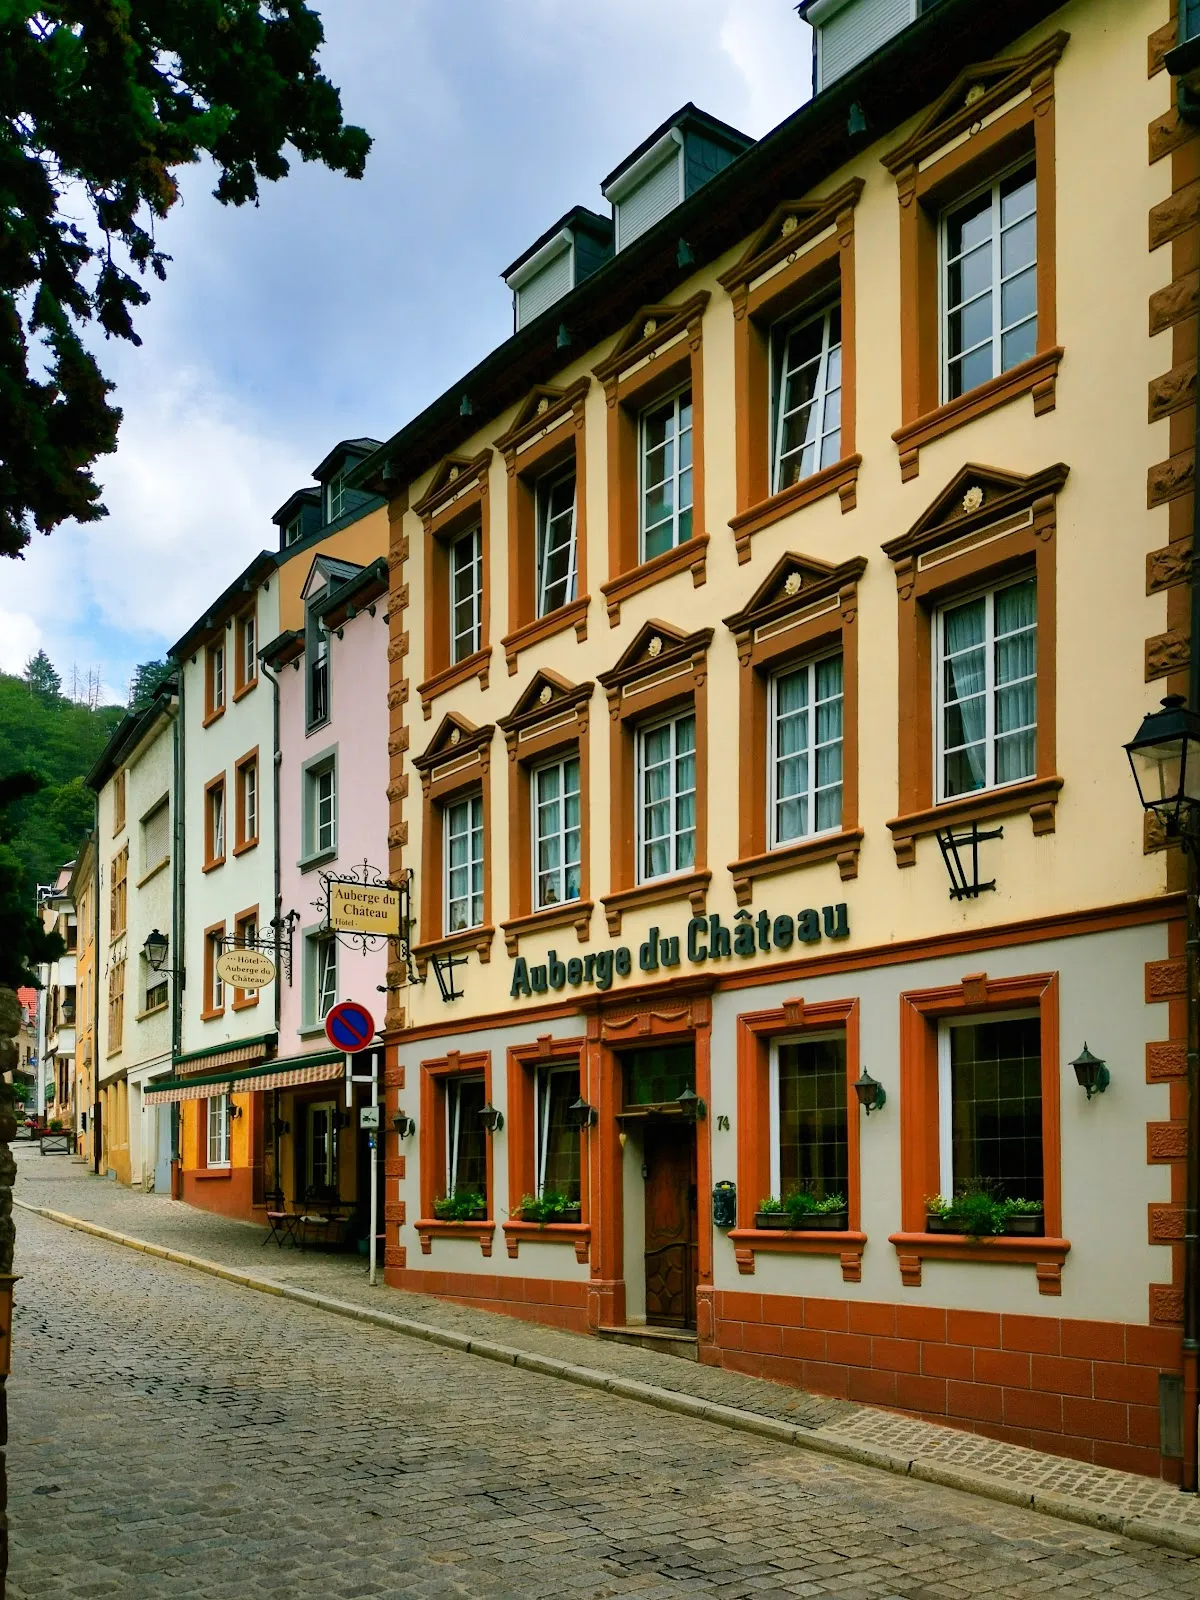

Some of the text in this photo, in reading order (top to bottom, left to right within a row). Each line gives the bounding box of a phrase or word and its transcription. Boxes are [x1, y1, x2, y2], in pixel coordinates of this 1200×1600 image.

[335, 889, 396, 905] Auberge du
[343, 904, 388, 919] Château
[335, 918, 354, 926] Hôtel
[509, 903, 851, 997] Auberge du Château
[238, 956, 259, 964] Hôtel
[226, 965, 259, 974] Auberge
[232, 975, 265, 983] Château
[717, 1115, 730, 1131] 74
